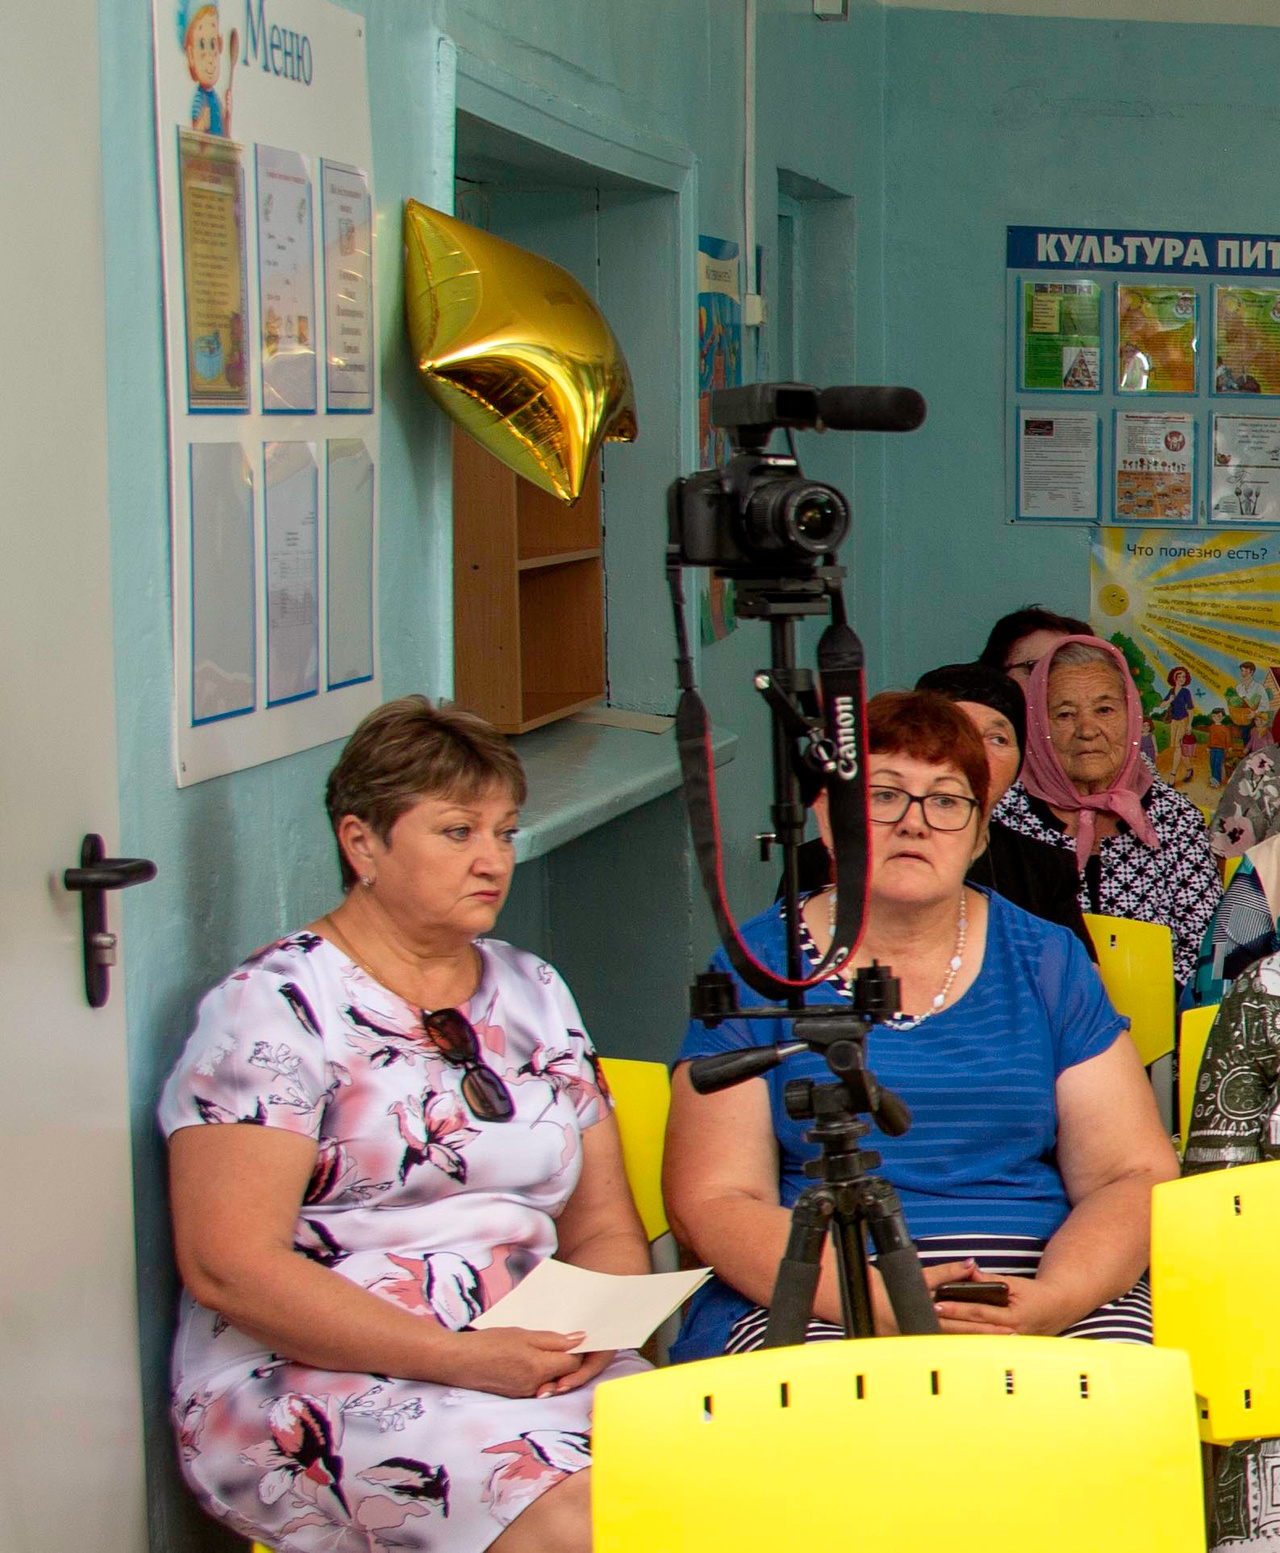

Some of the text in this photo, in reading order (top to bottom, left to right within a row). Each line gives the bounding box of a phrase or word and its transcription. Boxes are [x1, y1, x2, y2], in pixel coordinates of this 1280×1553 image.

[243, 0, 313, 86] Меню
[1037, 232, 1209, 267] КУЛЬТУРА
[1127, 544, 1268, 560] Что полезно есть?
[834, 696, 859, 781] Canon
